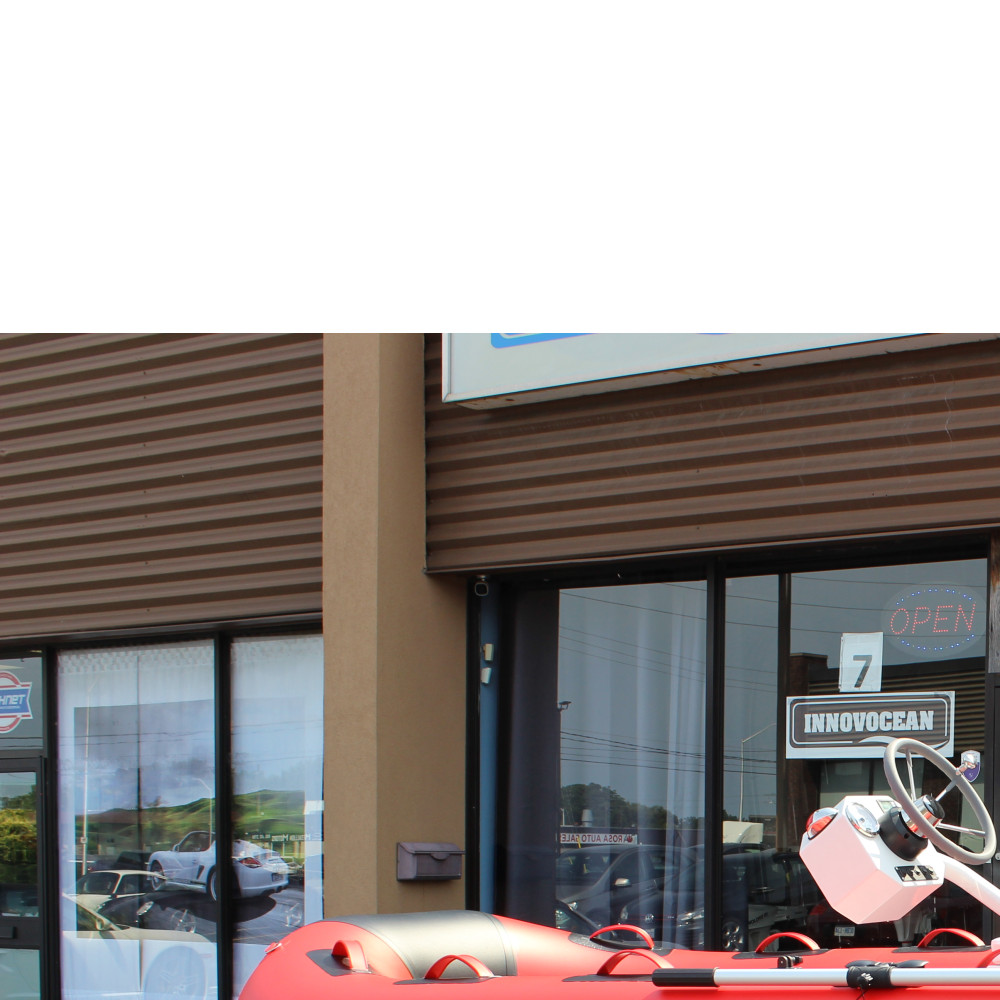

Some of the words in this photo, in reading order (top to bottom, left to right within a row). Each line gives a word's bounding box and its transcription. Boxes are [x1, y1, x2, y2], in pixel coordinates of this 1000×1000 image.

[890, 604, 976, 634] OPEN
[852, 654, 873, 688] 7
[804, 711, 934, 733] INNOVOCEAN
